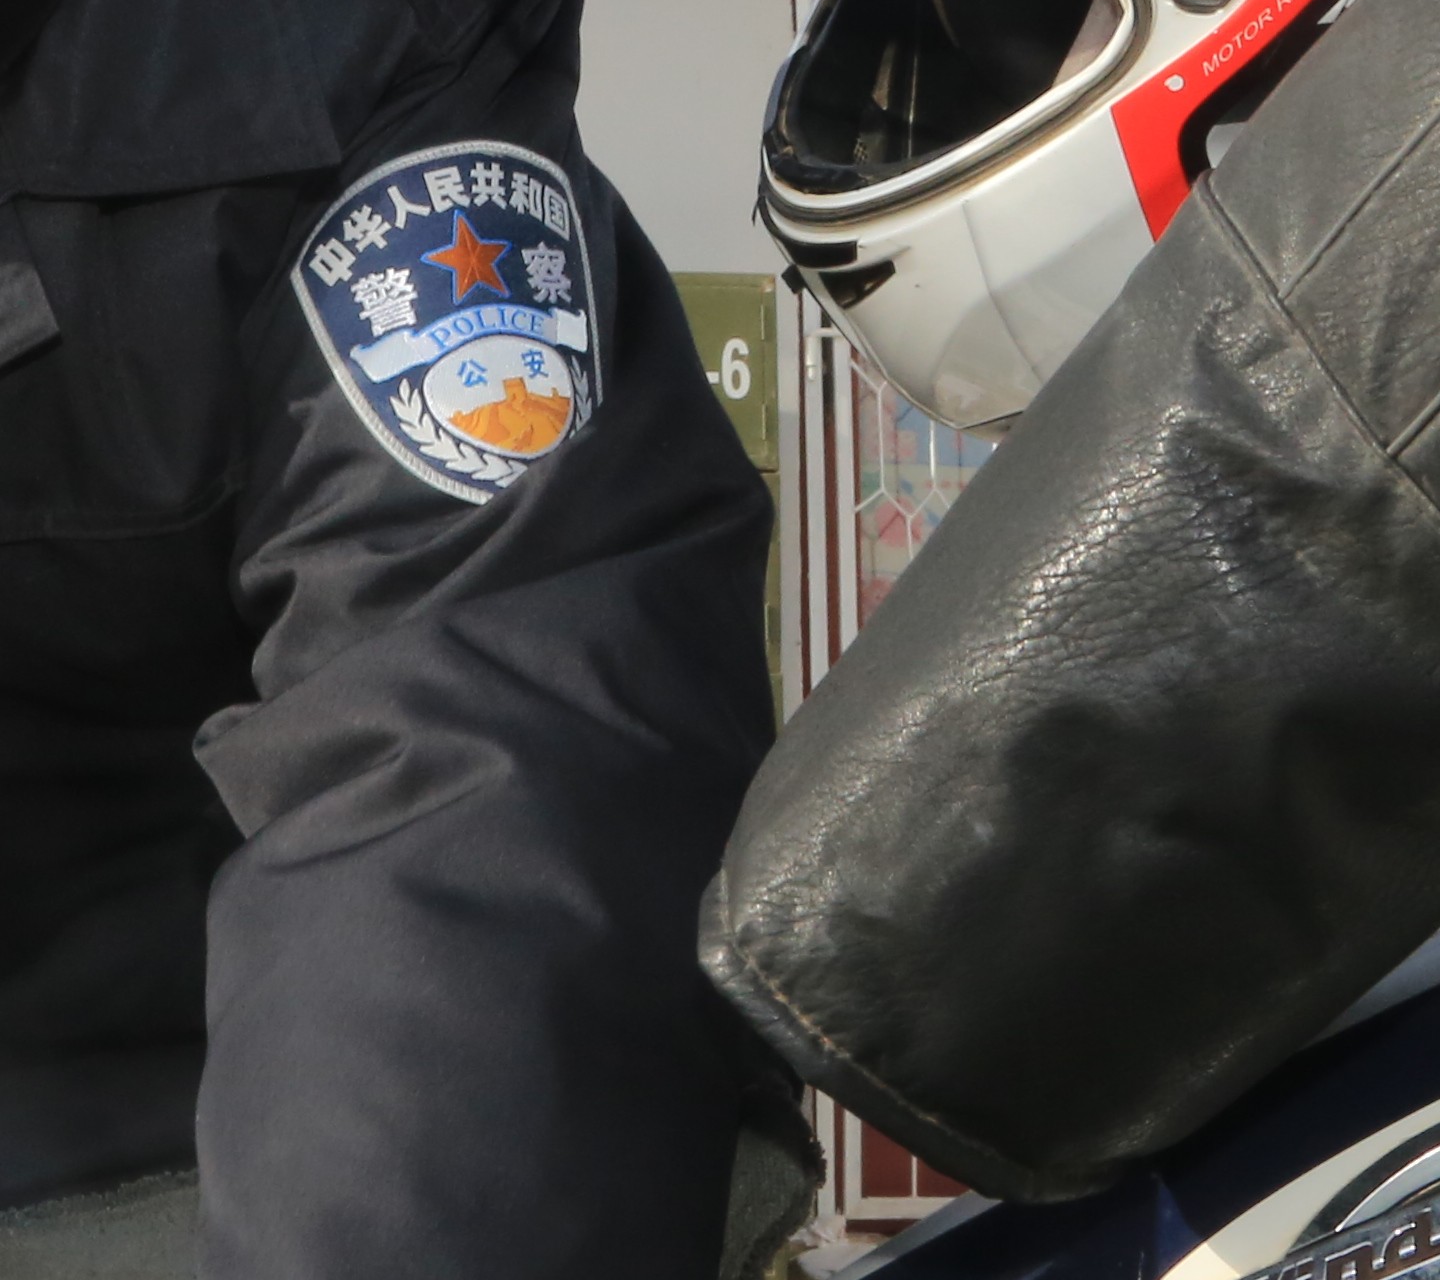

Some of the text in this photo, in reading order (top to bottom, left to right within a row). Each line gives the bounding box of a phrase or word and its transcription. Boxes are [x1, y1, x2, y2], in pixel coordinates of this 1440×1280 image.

[1202, 7, 1274, 77] MOTOR
[308, 162, 572, 288] 中华人民共和国
[429, 306, 546, 352] POLICE
[705, 337, 752, 399] -6
